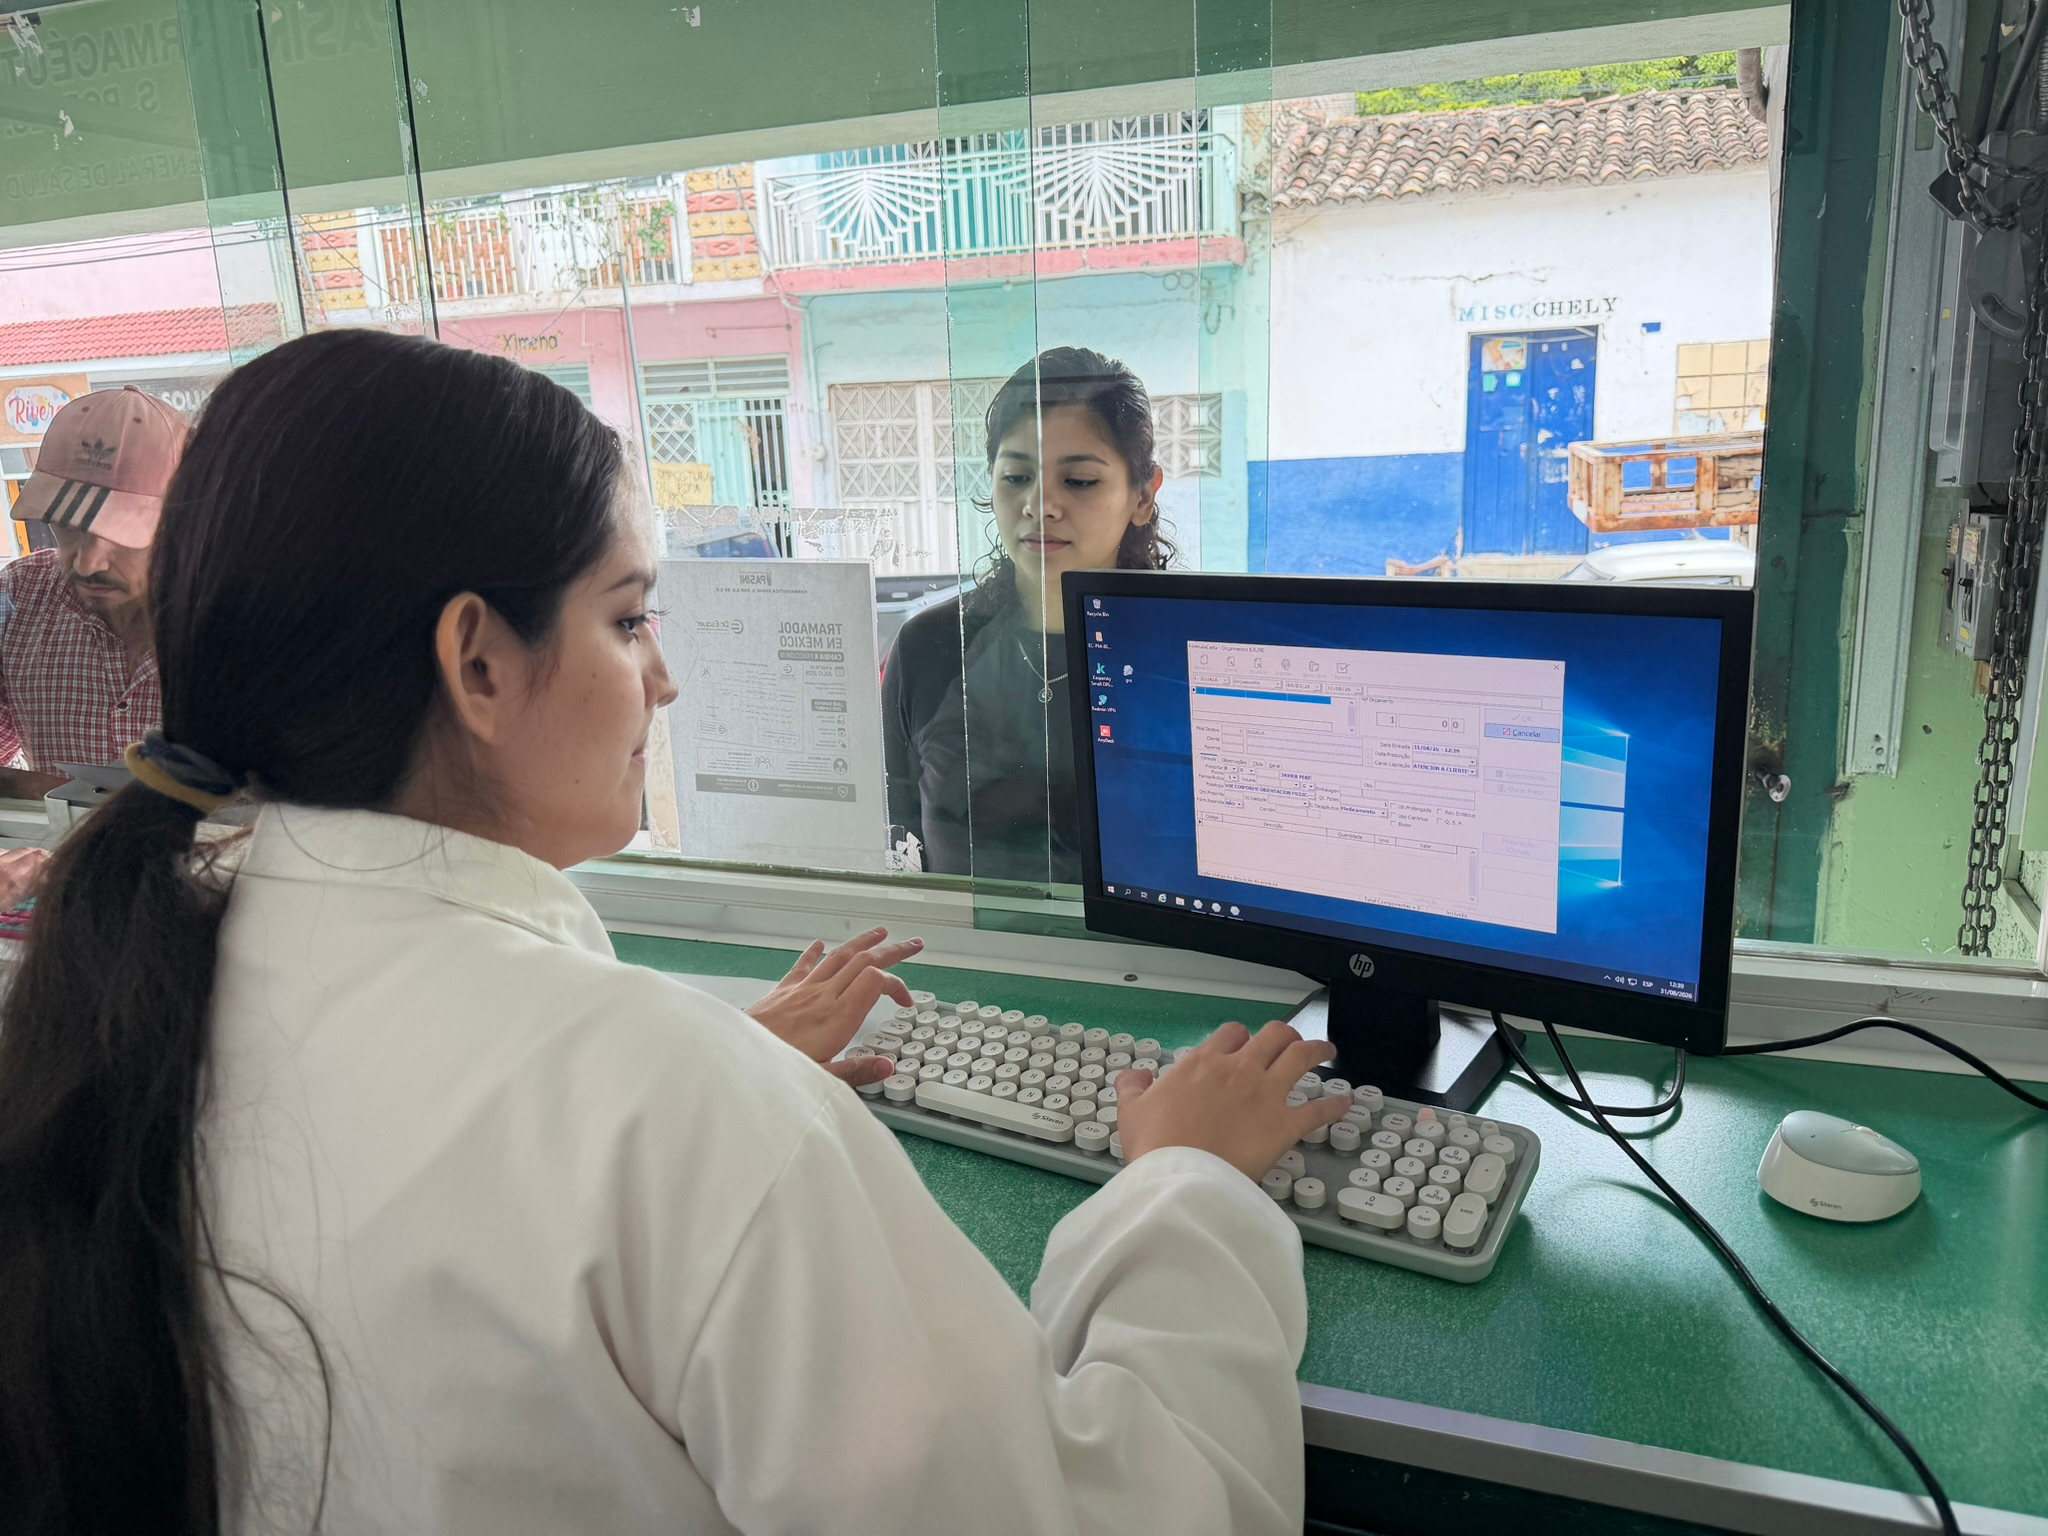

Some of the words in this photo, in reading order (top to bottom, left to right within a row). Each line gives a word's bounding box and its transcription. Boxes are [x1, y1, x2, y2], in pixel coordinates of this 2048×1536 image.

[1533, 297, 1618, 318] CHELY
[1441, 720, 1448, 728] 0
[1512, 728, 1542, 738] Cancelar
[1340, 806, 1376, 815] Medicamento
[1669, 981, 1685, 989] 12:39
[1660, 988, 1693, 999] 31/08/2026
[1040, 1115, 1064, 1126] Steren
[1820, 1201, 1842, 1209] Steren
